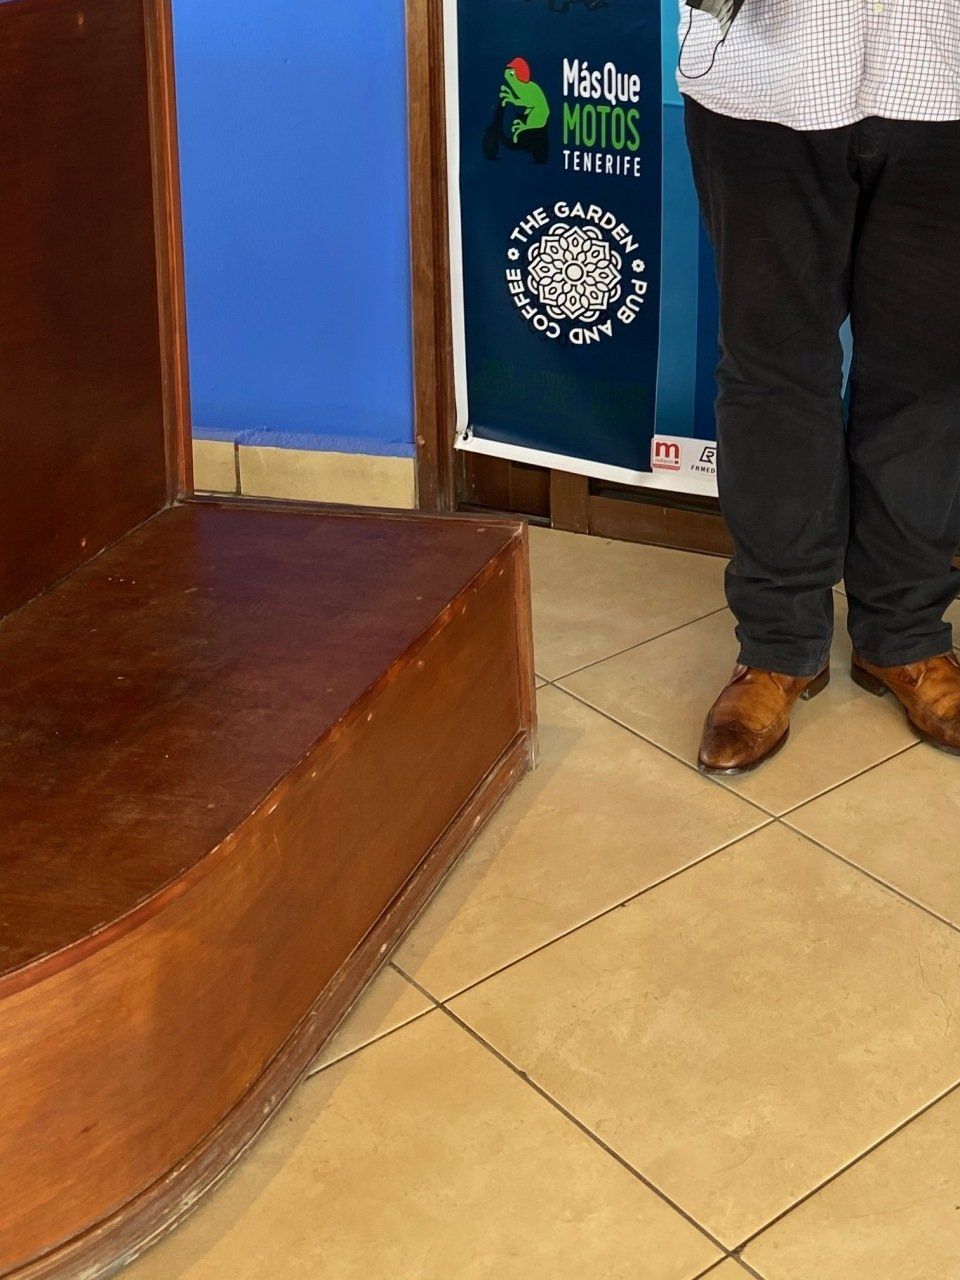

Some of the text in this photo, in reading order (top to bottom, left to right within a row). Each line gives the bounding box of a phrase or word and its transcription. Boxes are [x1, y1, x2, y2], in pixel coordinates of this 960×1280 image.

[563, 57, 641, 105] MásQue
[563, 102, 641, 151] MOTOS
[562, 149, 642, 178] TENERIFE
[506, 201, 648, 345] THE GARDEN PUB AND COFFEE
[690, 464, 716, 474] FRMED
